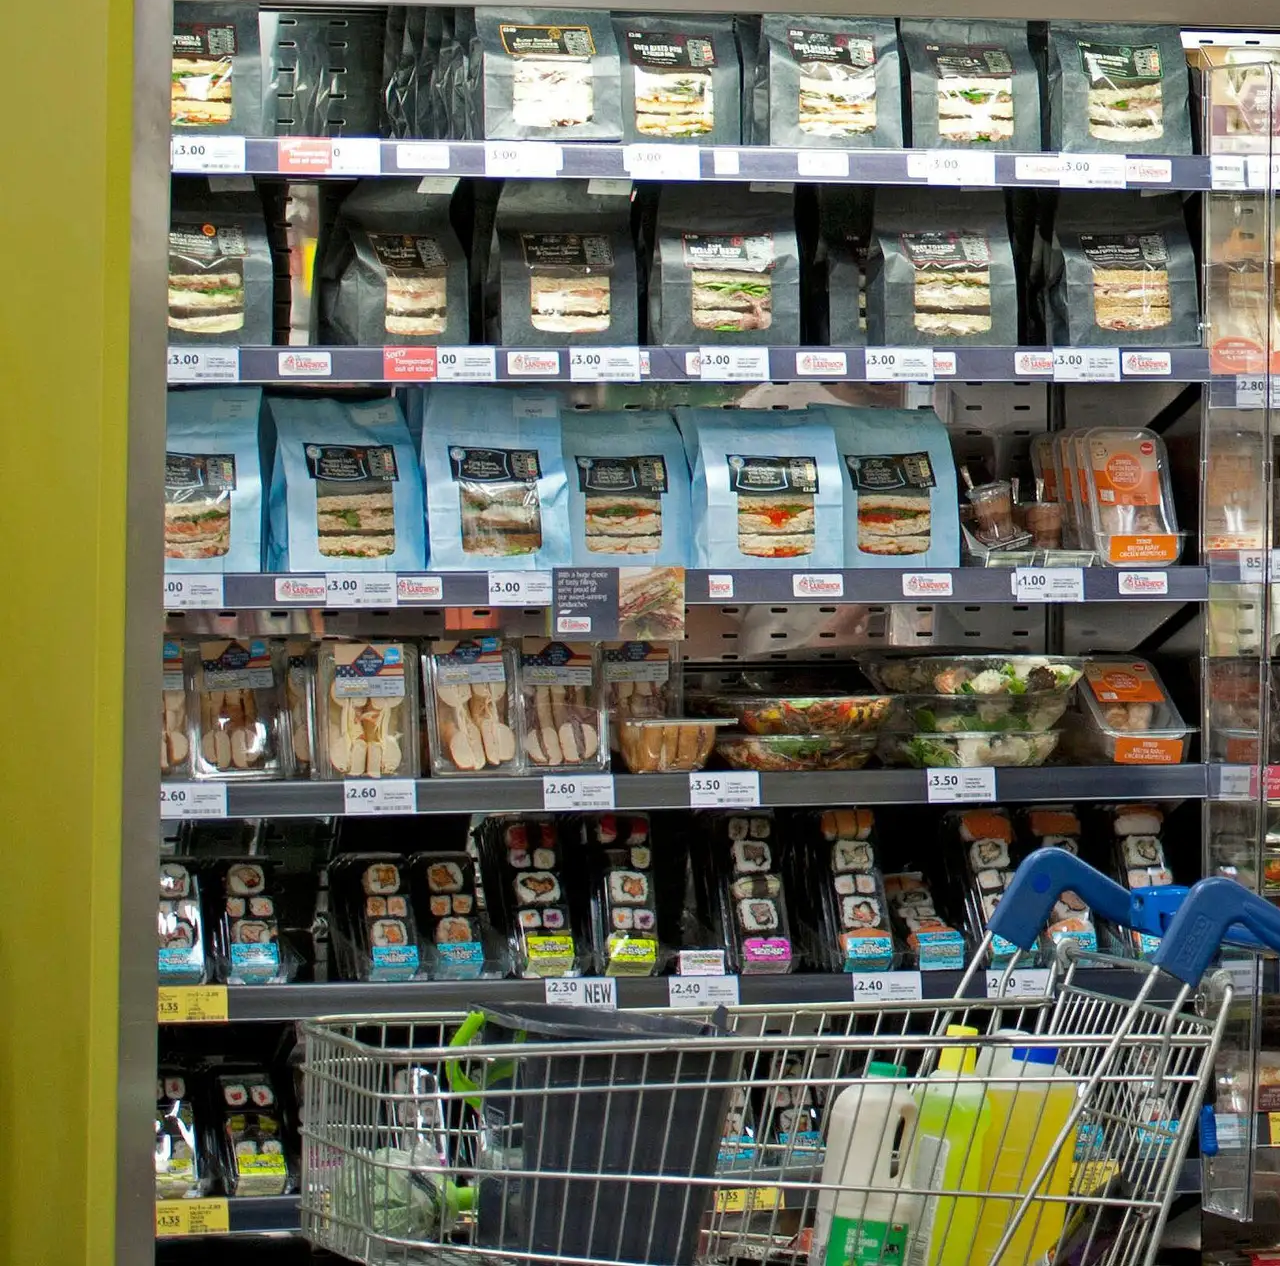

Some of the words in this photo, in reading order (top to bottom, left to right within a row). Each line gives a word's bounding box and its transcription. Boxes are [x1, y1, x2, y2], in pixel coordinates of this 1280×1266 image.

[571, 354, 601, 366] £3.00
[701, 354, 730, 366] £3.00
[866, 354, 896, 366] £3.00
[1055, 354, 1083, 366] £3.00
[327, 580, 358, 592] £3.00
[1019, 575, 1046, 586] £1.00
[490, 582, 520, 593] £3.00
[690, 780, 720, 792] £3.50
[929, 775, 958, 787] £3.50
[346, 788, 377, 799] £2.60
[546, 783, 576, 795] £2.60
[854, 979, 883, 991] £2.40
[988, 977, 1015, 988] £20
[547, 982, 577, 993] £2.30
[584, 983, 612, 1004] NEW
[670, 983, 700, 995] £2.40
